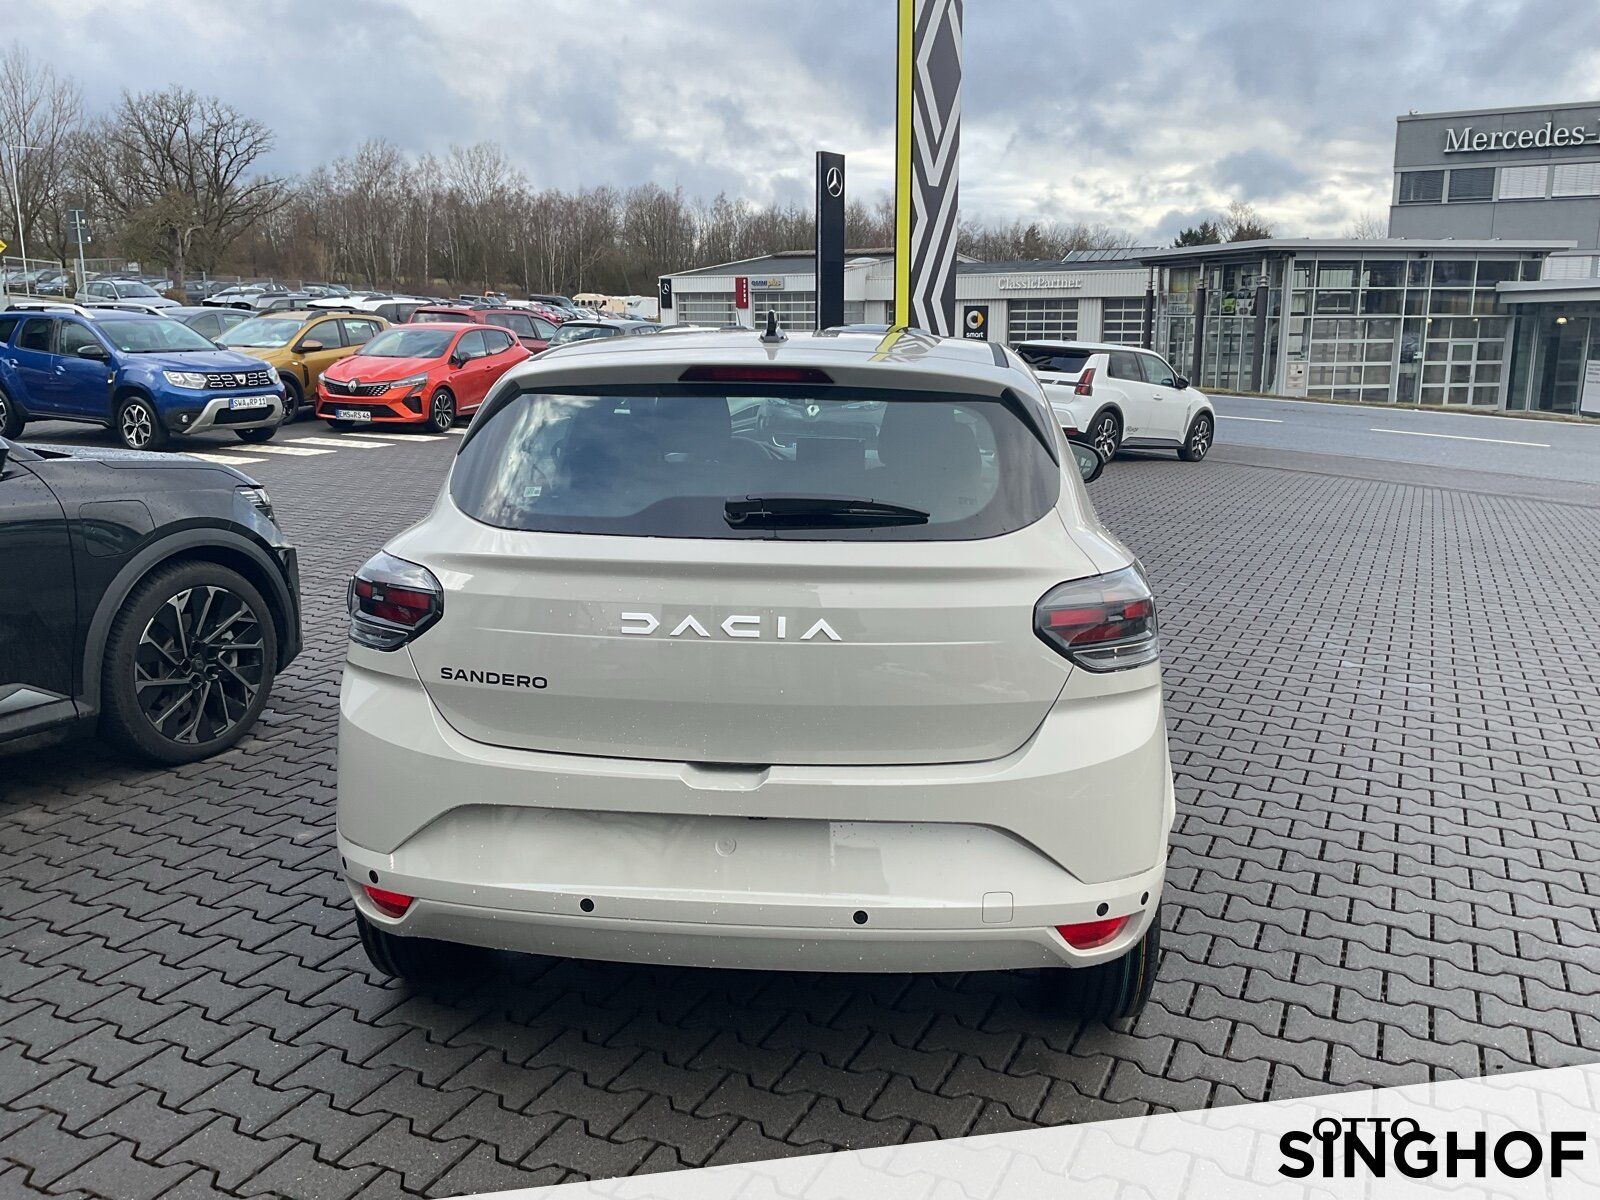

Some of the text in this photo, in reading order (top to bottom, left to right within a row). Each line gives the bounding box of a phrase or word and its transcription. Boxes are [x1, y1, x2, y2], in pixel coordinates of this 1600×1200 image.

[1444, 118, 1600, 153] Mercedes-
[621, 612, 842, 641] DACIA
[440, 667, 548, 689] SANDERO
